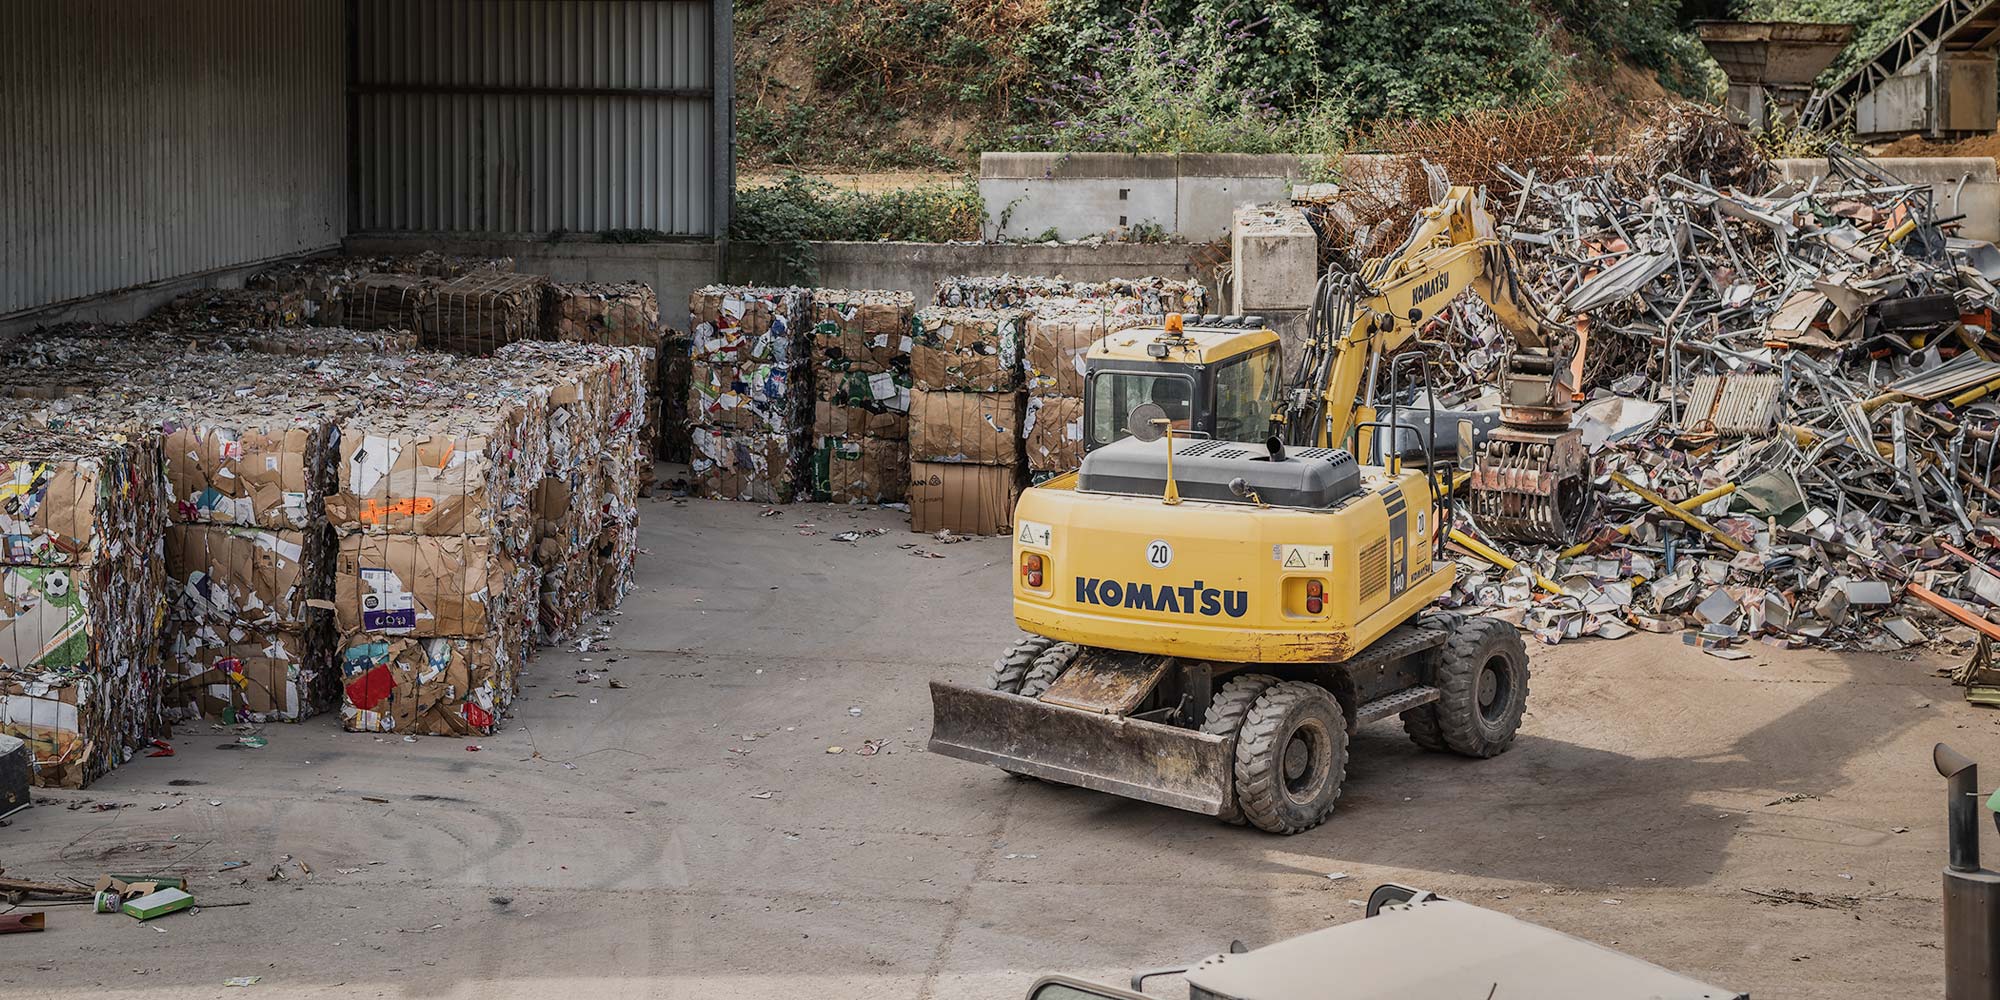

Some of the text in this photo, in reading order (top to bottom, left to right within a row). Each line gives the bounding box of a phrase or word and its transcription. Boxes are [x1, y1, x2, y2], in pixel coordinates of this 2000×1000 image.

[1412, 270, 1449, 306] KOMATSU
[1418, 514, 1424, 533] 20
[1151, 545, 1168, 564] 20
[1393, 574, 1404, 594] 140
[1076, 576, 1248, 618] KOMATSU
